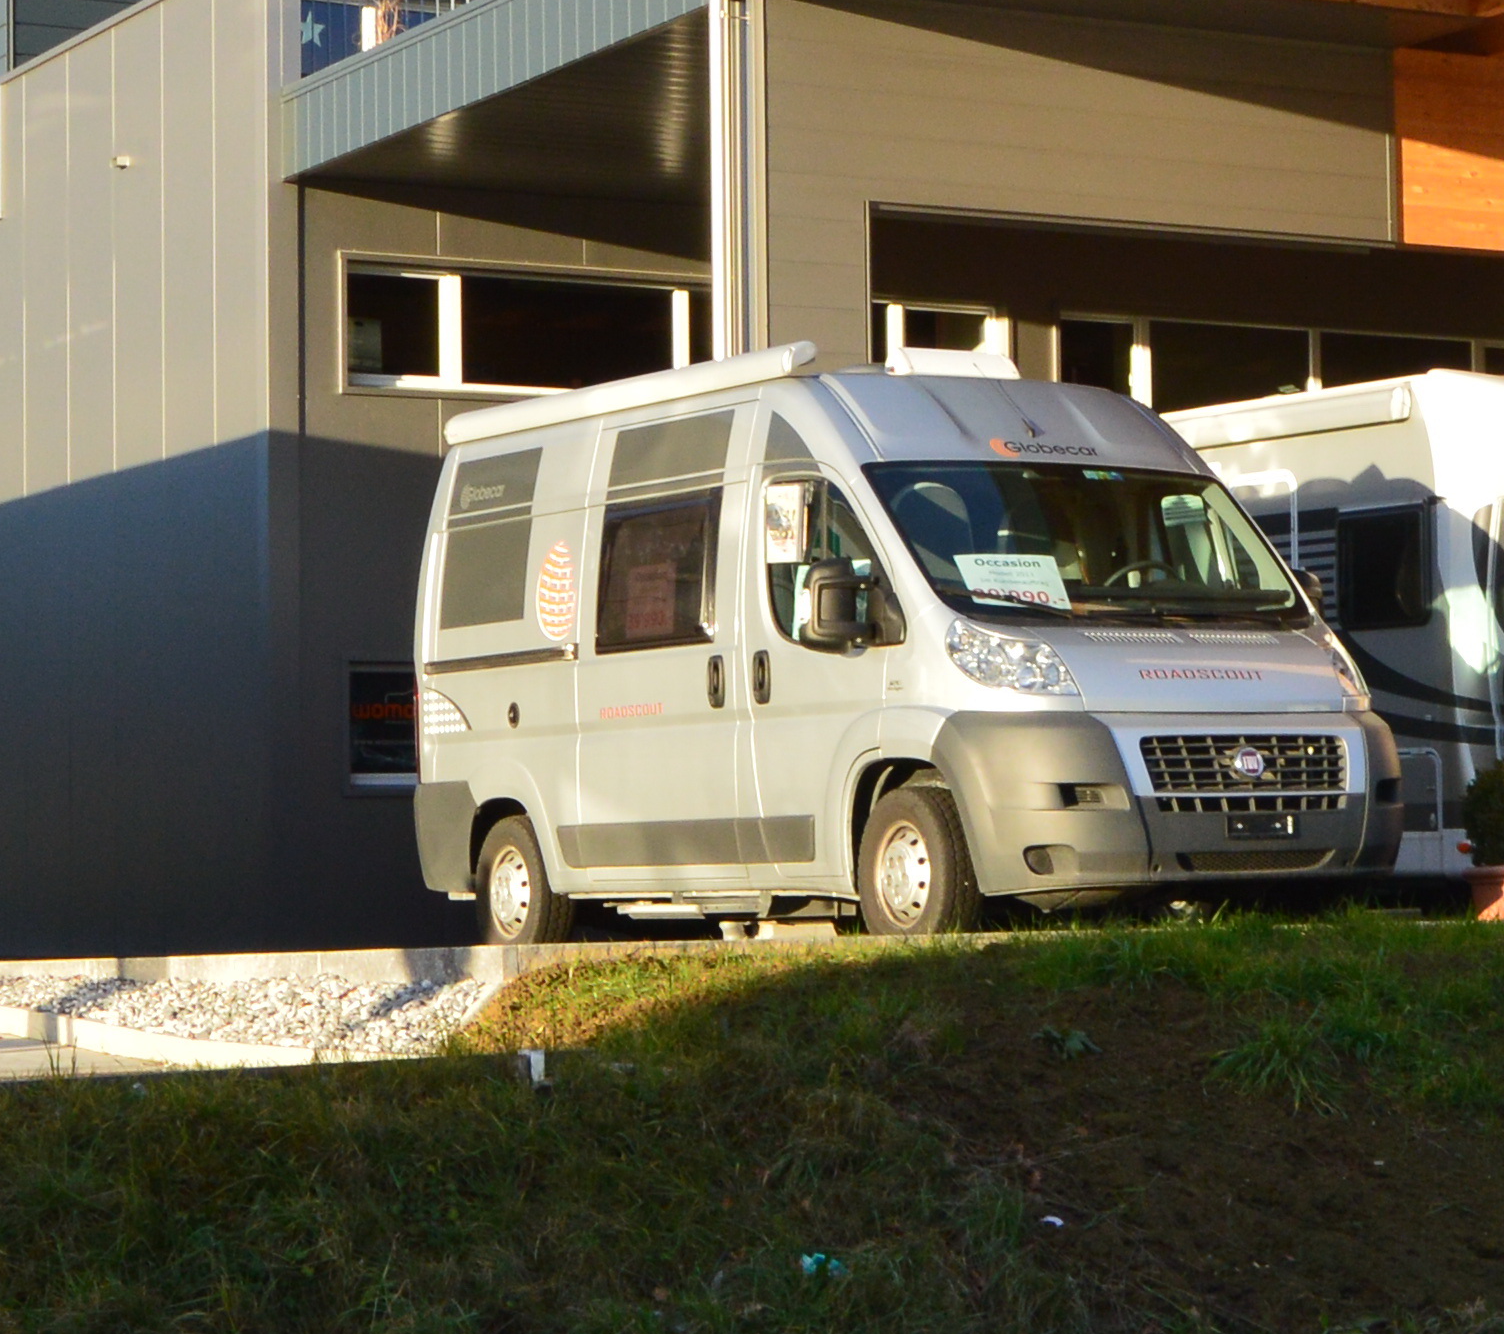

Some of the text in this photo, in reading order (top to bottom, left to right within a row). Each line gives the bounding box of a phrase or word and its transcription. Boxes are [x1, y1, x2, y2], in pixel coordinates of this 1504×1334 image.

[1003, 441, 1098, 456] Globecar
[974, 557, 1042, 568] Occasion
[1139, 669, 1262, 681] ROADSCOUT
[600, 702, 664, 719] ROADSCOUT
